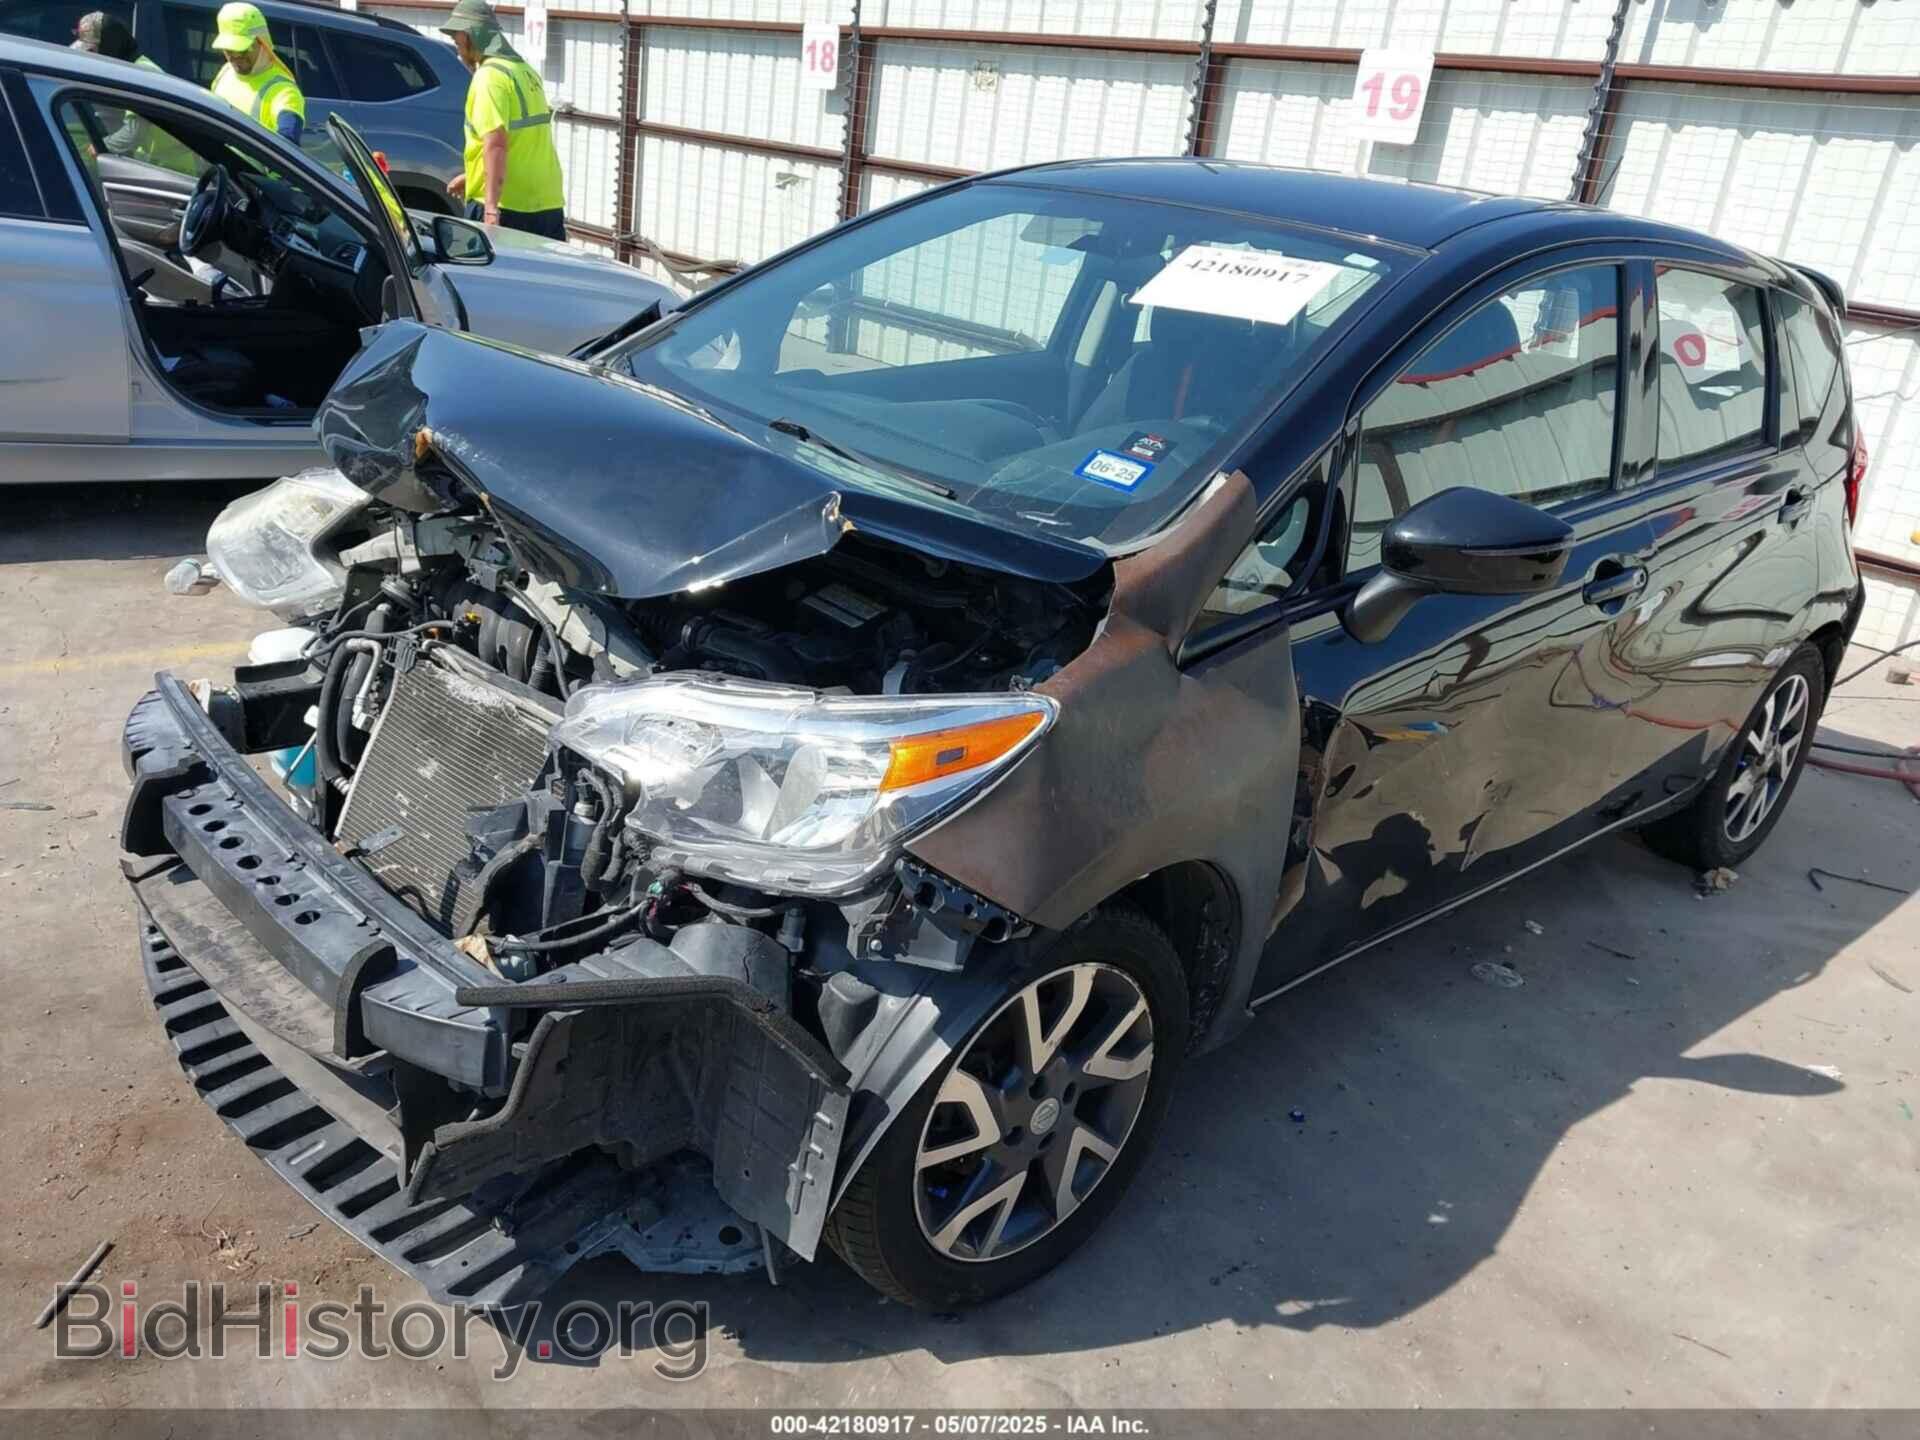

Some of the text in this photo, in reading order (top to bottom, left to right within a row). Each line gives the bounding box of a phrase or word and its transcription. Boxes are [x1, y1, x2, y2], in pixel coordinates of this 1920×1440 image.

[806, 39, 835, 72] 18
[1362, 72, 1421, 120] 19
[1186, 258, 1310, 284] 42180917
